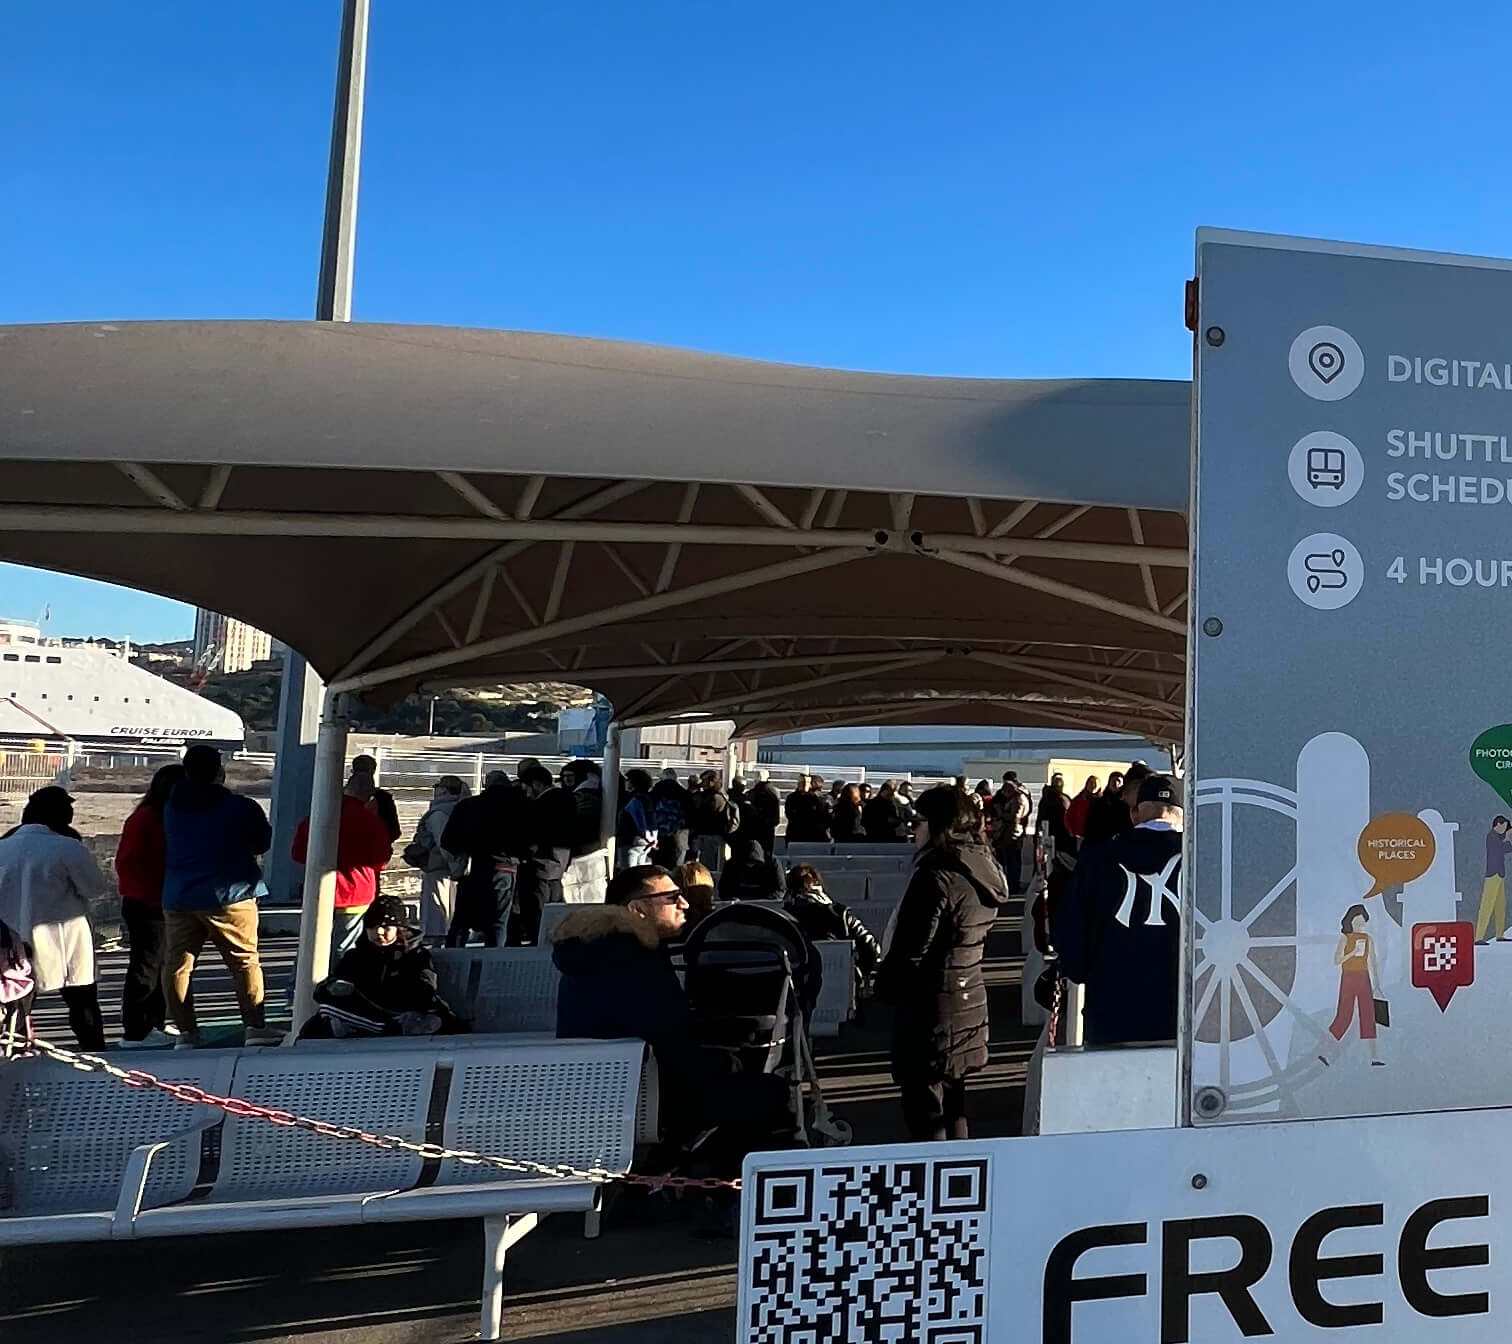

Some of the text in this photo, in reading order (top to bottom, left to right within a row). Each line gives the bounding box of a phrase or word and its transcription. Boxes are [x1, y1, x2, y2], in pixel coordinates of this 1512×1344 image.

[1386, 556, 1408, 584] 4
[110, 726, 214, 737] CRUISE EUROPA
[1367, 839, 1426, 848] HISTORICAL
[1378, 850, 1416, 860] PLACES
